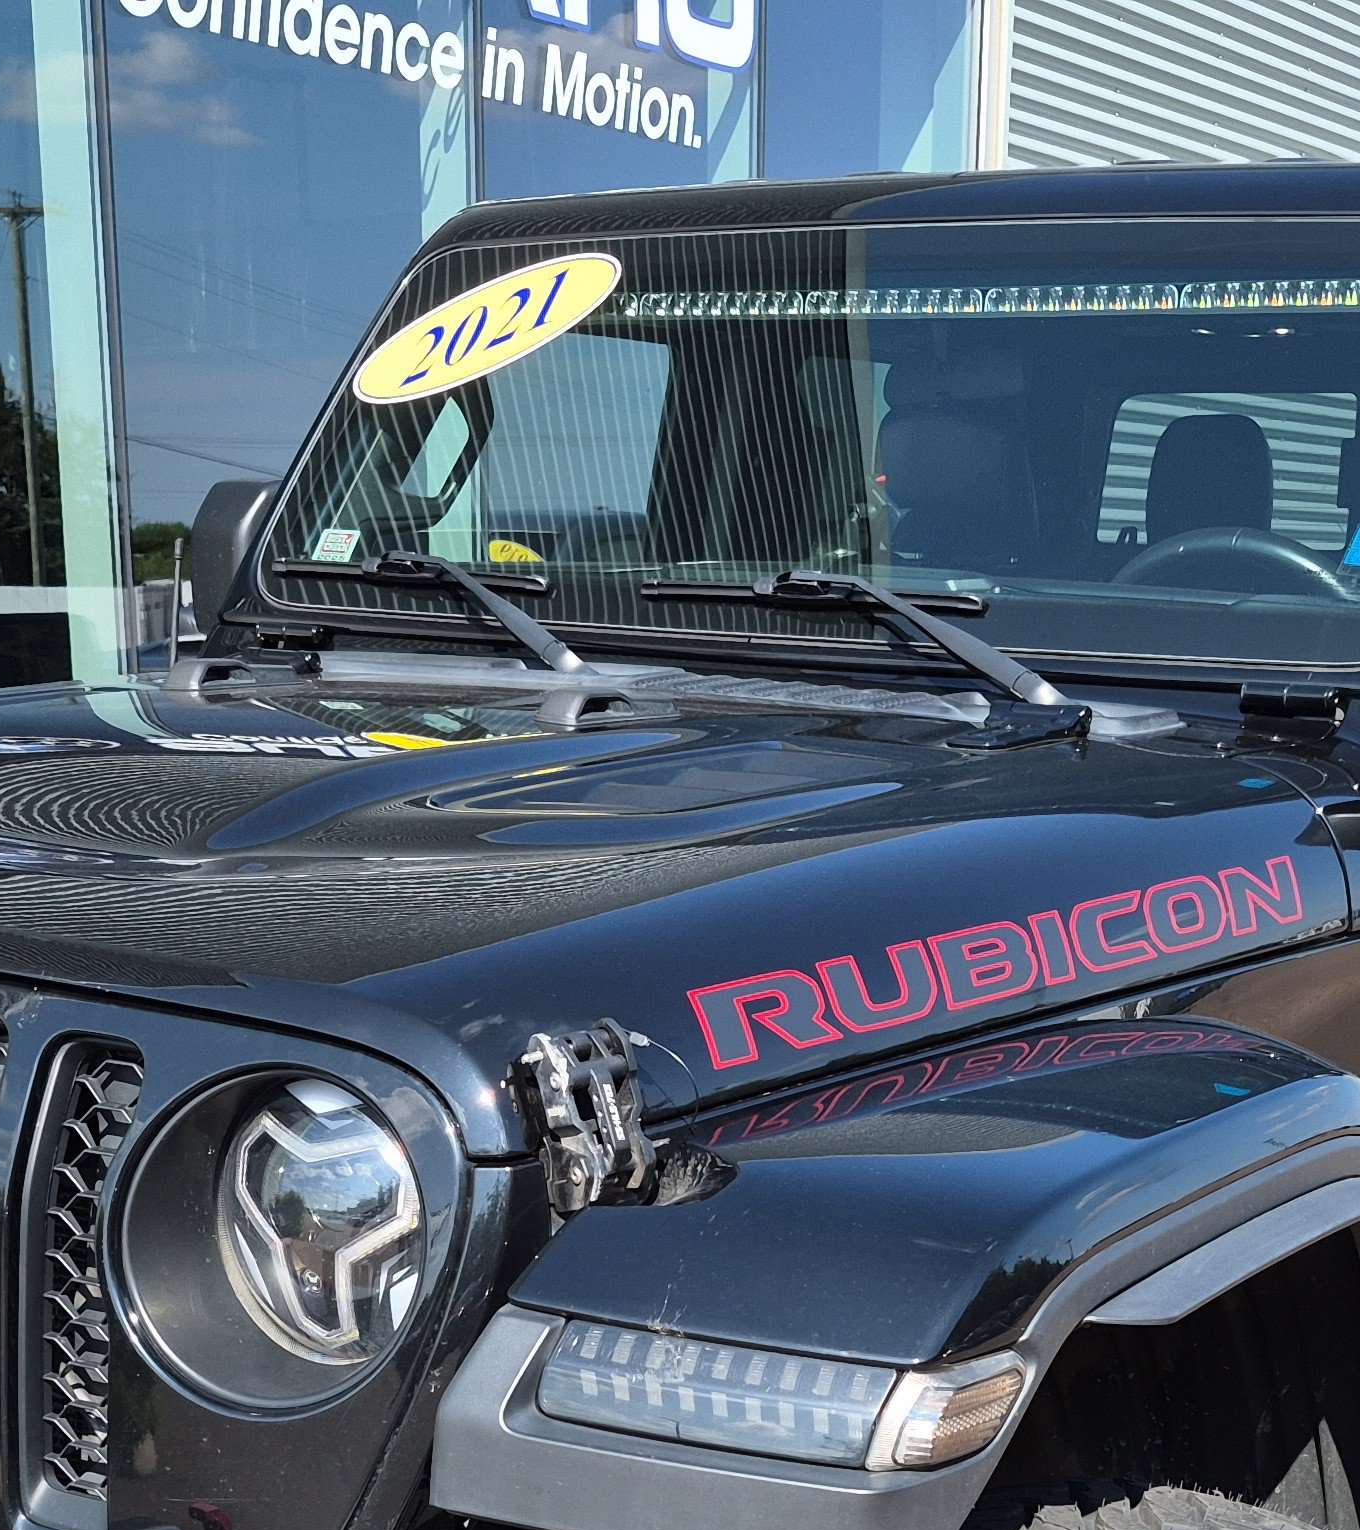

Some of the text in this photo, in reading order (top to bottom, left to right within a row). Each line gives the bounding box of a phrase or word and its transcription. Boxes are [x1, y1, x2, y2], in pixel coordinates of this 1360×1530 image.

[119, 0, 464, 89] nfidence
[481, 26, 525, 106] in
[542, 43, 702, 149] Motion.
[399, 268, 570, 388] 2021
[686, 855, 1303, 1071] RUBICON
